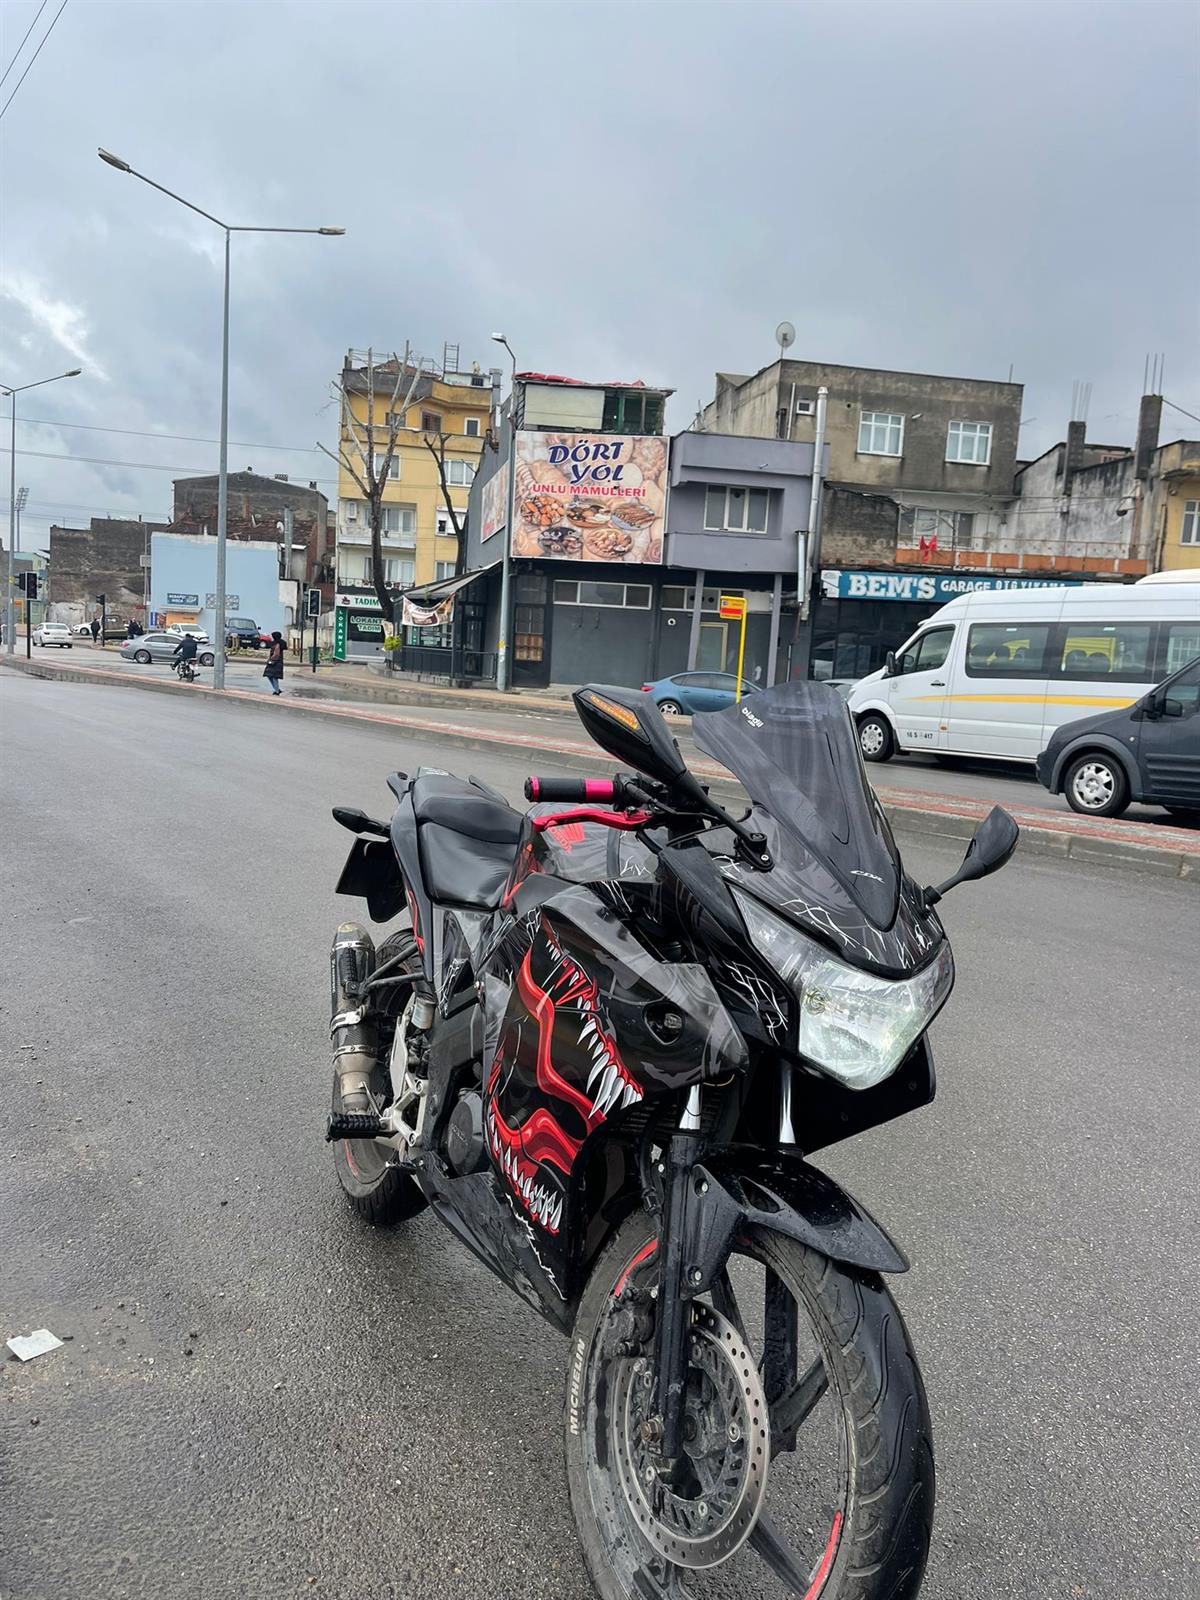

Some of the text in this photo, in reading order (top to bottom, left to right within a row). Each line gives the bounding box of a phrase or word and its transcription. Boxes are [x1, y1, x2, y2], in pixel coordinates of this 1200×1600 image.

[549, 440, 625, 464] DÖRT
[570, 464, 624, 484] YOL
[532, 484, 646, 497] UNLU MAMULLERİ
[848, 574, 936, 600] BEM'S
[940, 579, 991, 593] GARAGE
[1021, 581, 1066, 589] YIK
[337, 610, 345, 653] LOKANTA
[350, 616, 385, 625] LOKANT
[570, 1338, 586, 1436] MICHELIN
